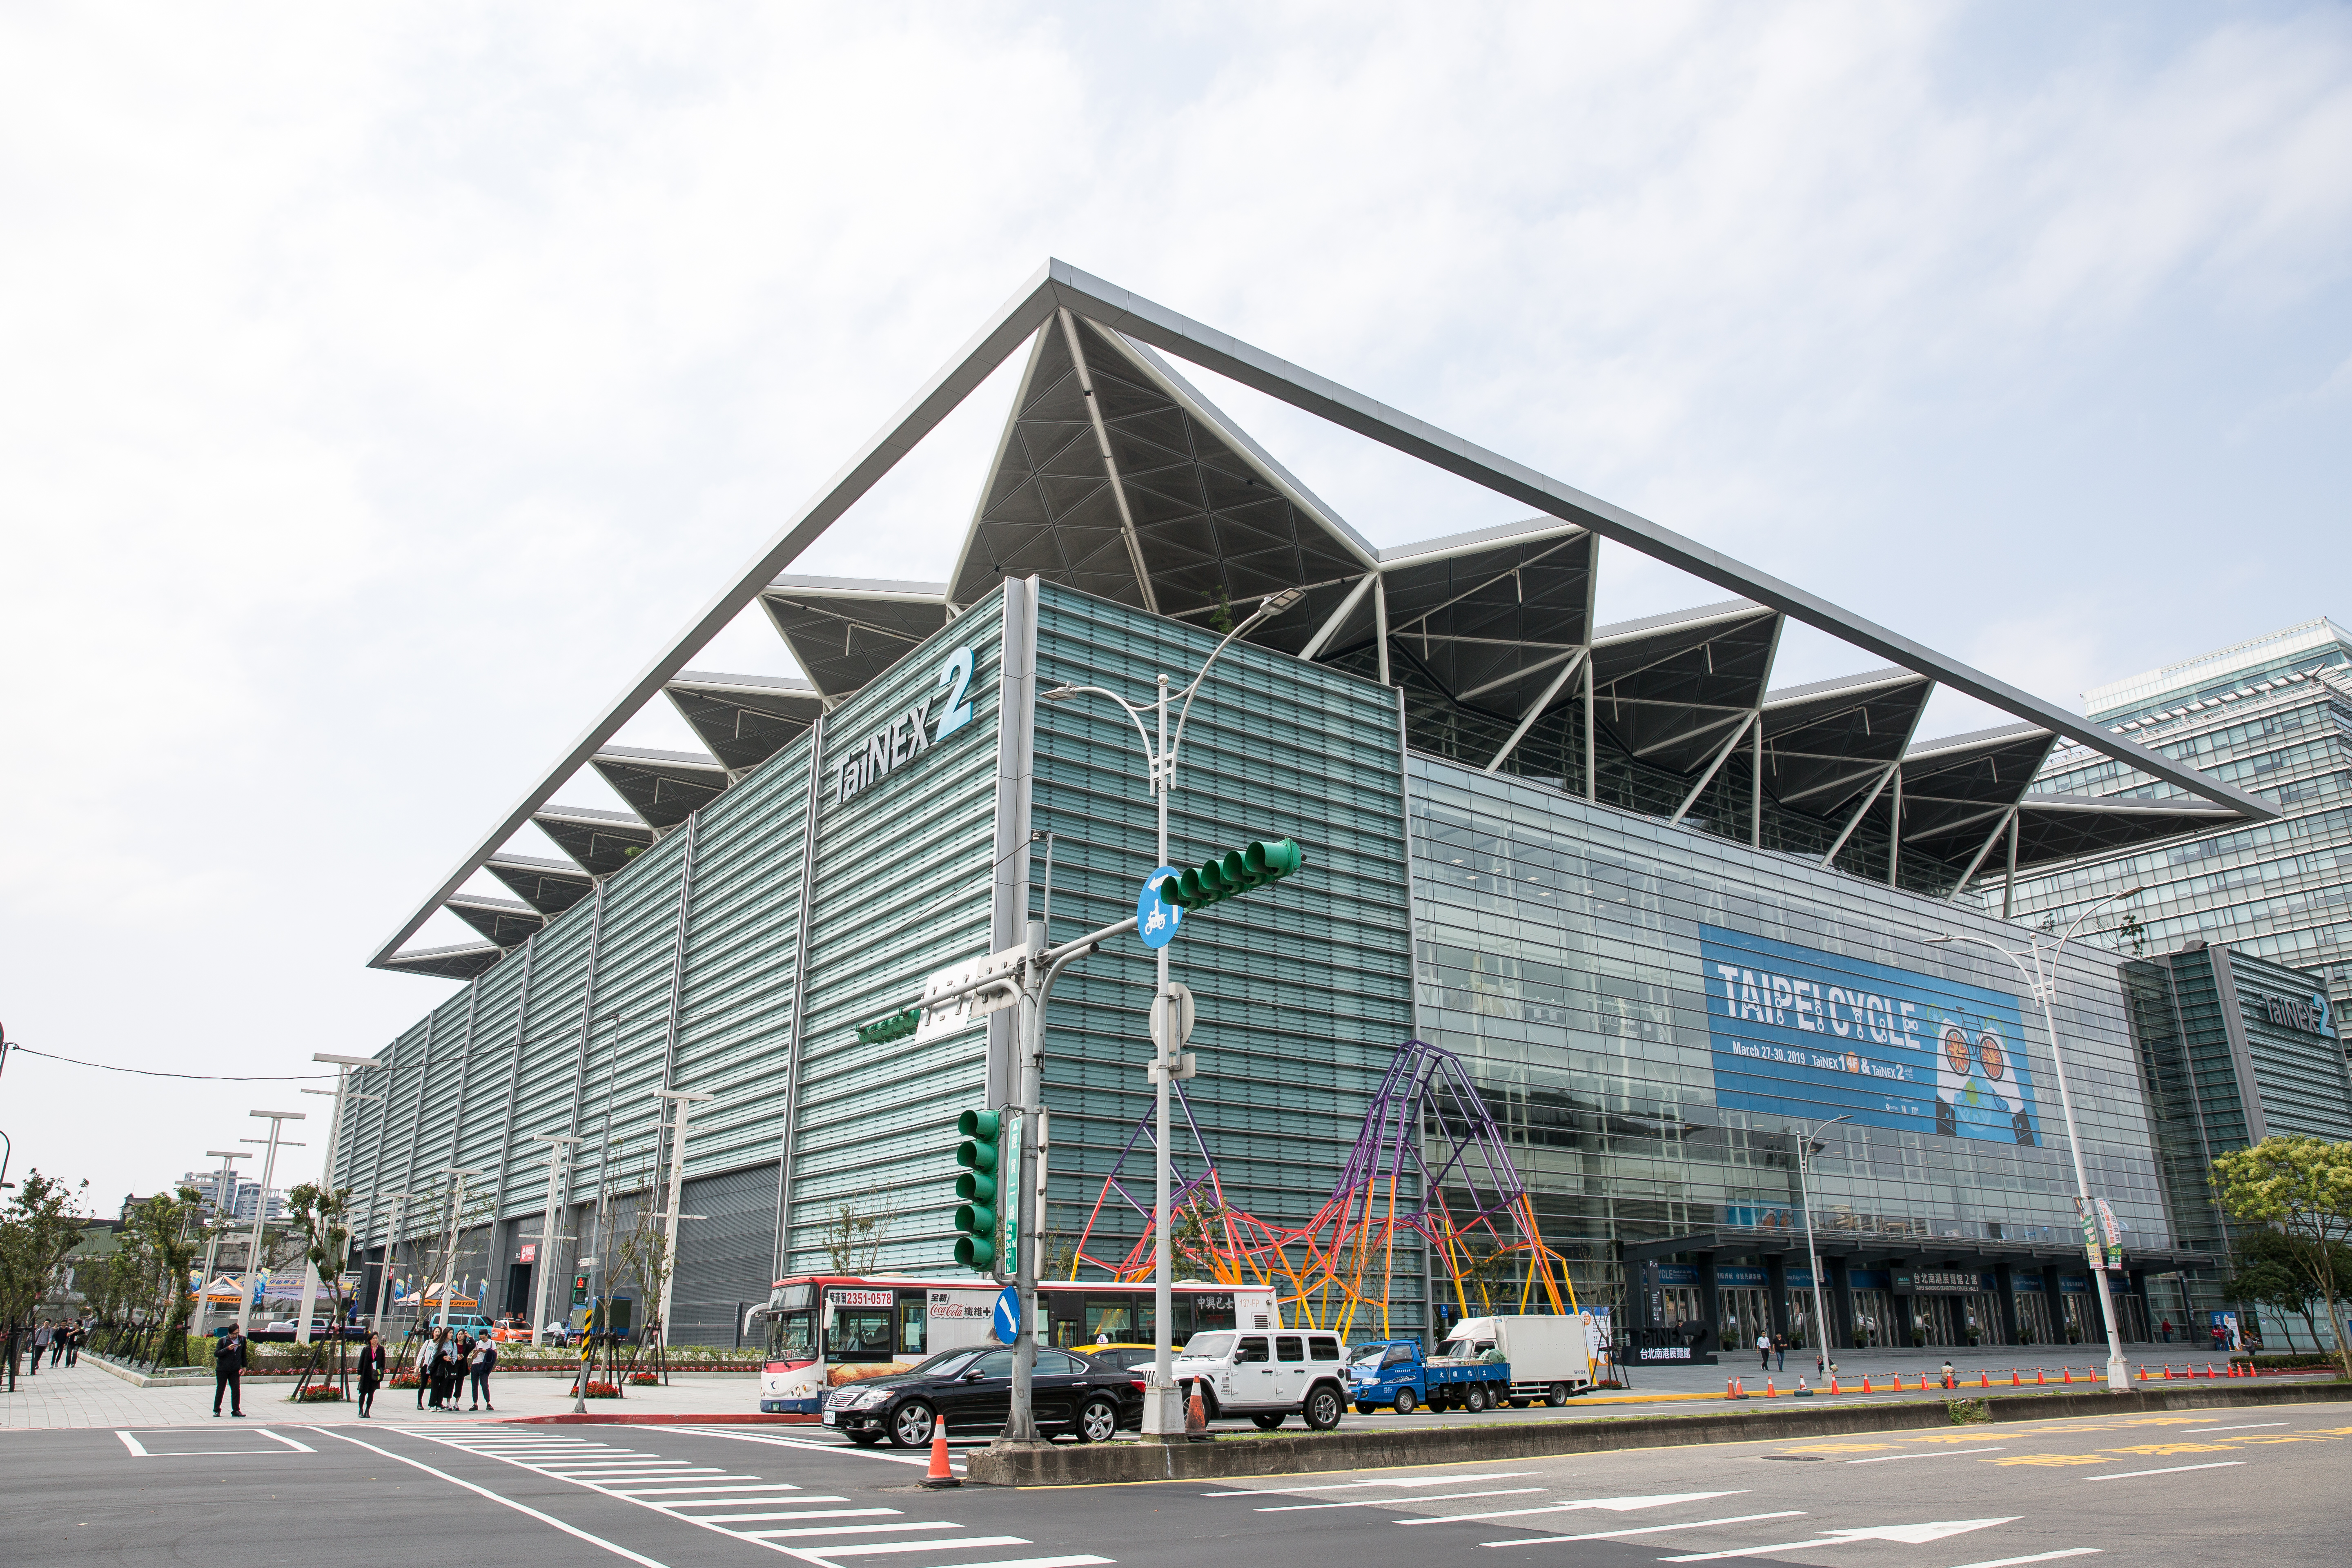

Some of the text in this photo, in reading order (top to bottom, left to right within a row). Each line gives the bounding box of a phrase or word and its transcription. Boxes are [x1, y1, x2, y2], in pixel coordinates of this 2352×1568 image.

[833, 646, 975, 805] TaiNEX 2
[1717, 964, 1920, 1049] TAIPEI CYCLE
[2260, 993, 2336, 1038] TaiNEX 2
[1732, 1041, 1760, 1057] March
[1787, 1050, 1806, 1064] 2019
[1811, 1055, 1839, 1069] TaiNEX
[1847, 1057, 1858, 1069] 4F
[1861, 1058, 1871, 1074] &
[1871, 1065, 1896, 1078] TaiNEX
[1896, 1064, 1905, 1080] 2
[1009, 1133, 1018, 1221] 經貿二路
[1658, 1269, 1673, 1279] YCLE
[847, 1292, 892, 1305] 2351-0578
[930, 1293, 948, 1303] 全新
[1197, 1295, 1234, 1310] 中興巴士
[1240, 1298, 1259, 1307] 137-FP
[1640, 1347, 1691, 1359] 台北南港展覽館
[1439, 1370, 1487, 1378] 大順化工
